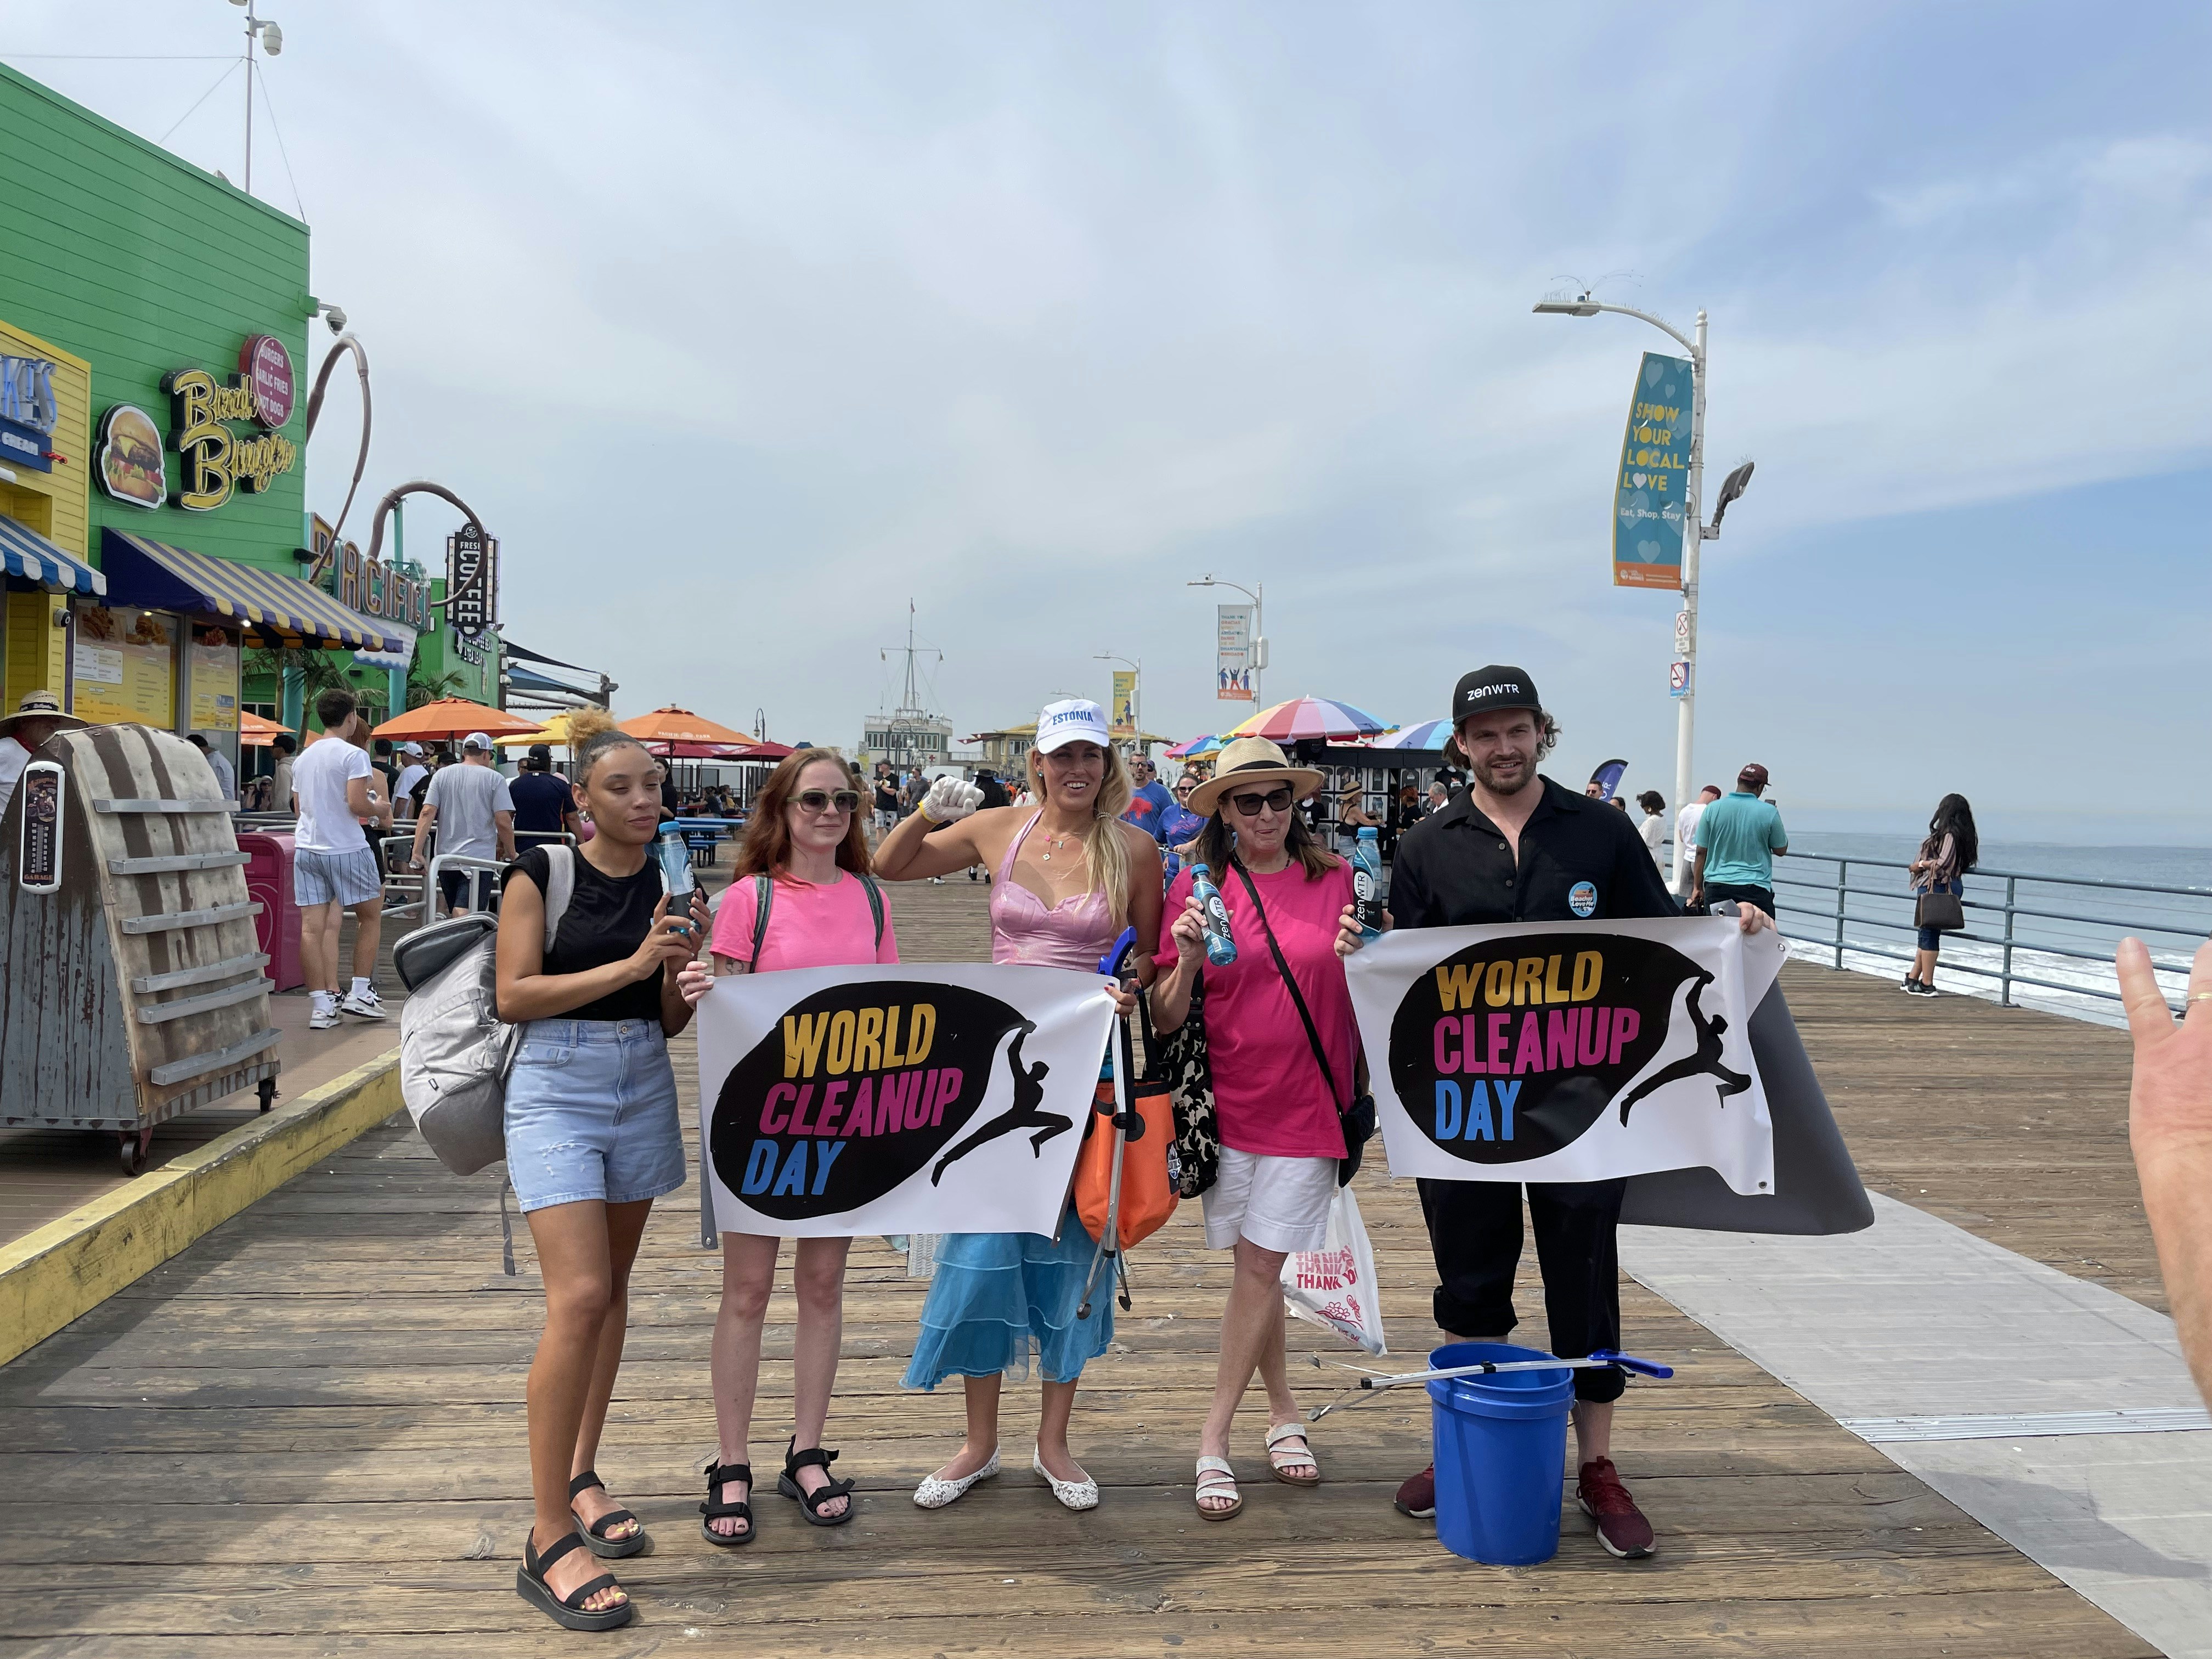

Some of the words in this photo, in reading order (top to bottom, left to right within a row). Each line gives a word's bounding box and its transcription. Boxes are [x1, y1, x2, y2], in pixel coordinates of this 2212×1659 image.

[260, 345, 284, 368] BURGERS
[274, 376, 288, 396] FRIES
[270, 399, 284, 417] DOGS
[1635, 402, 1679, 423] SHOW
[1633, 425, 1672, 446] YOUR
[1627, 448, 1685, 469] LOCAL
[1620, 507, 1635, 518] Eat,
[1637, 509, 1660, 520] Shop,
[1662, 510, 1681, 521] Stay
[310, 512, 422, 625] PACIFIC
[1467, 684, 1520, 701] zenWTR
[1053, 710, 1093, 726] ESTONIA
[1357, 875, 1365, 920] zenWTR
[1214, 900, 1231, 939] zenWTR
[1435, 951, 1603, 1012] WORLD
[783, 1003, 936, 1078] WORLD
[1433, 1006, 1640, 1075] CLEANUP
[759, 1067, 963, 1137] CLEANUP
[1435, 1079, 1522, 1141] DAY
[741, 1139, 847, 1197] DAY
[1296, 1261, 1342, 1274] THANK
[1297, 1274, 1343, 1290] THANK
[1342, 1268, 1358, 1285] YO
[1351, 1334, 1361, 1342] DAY
